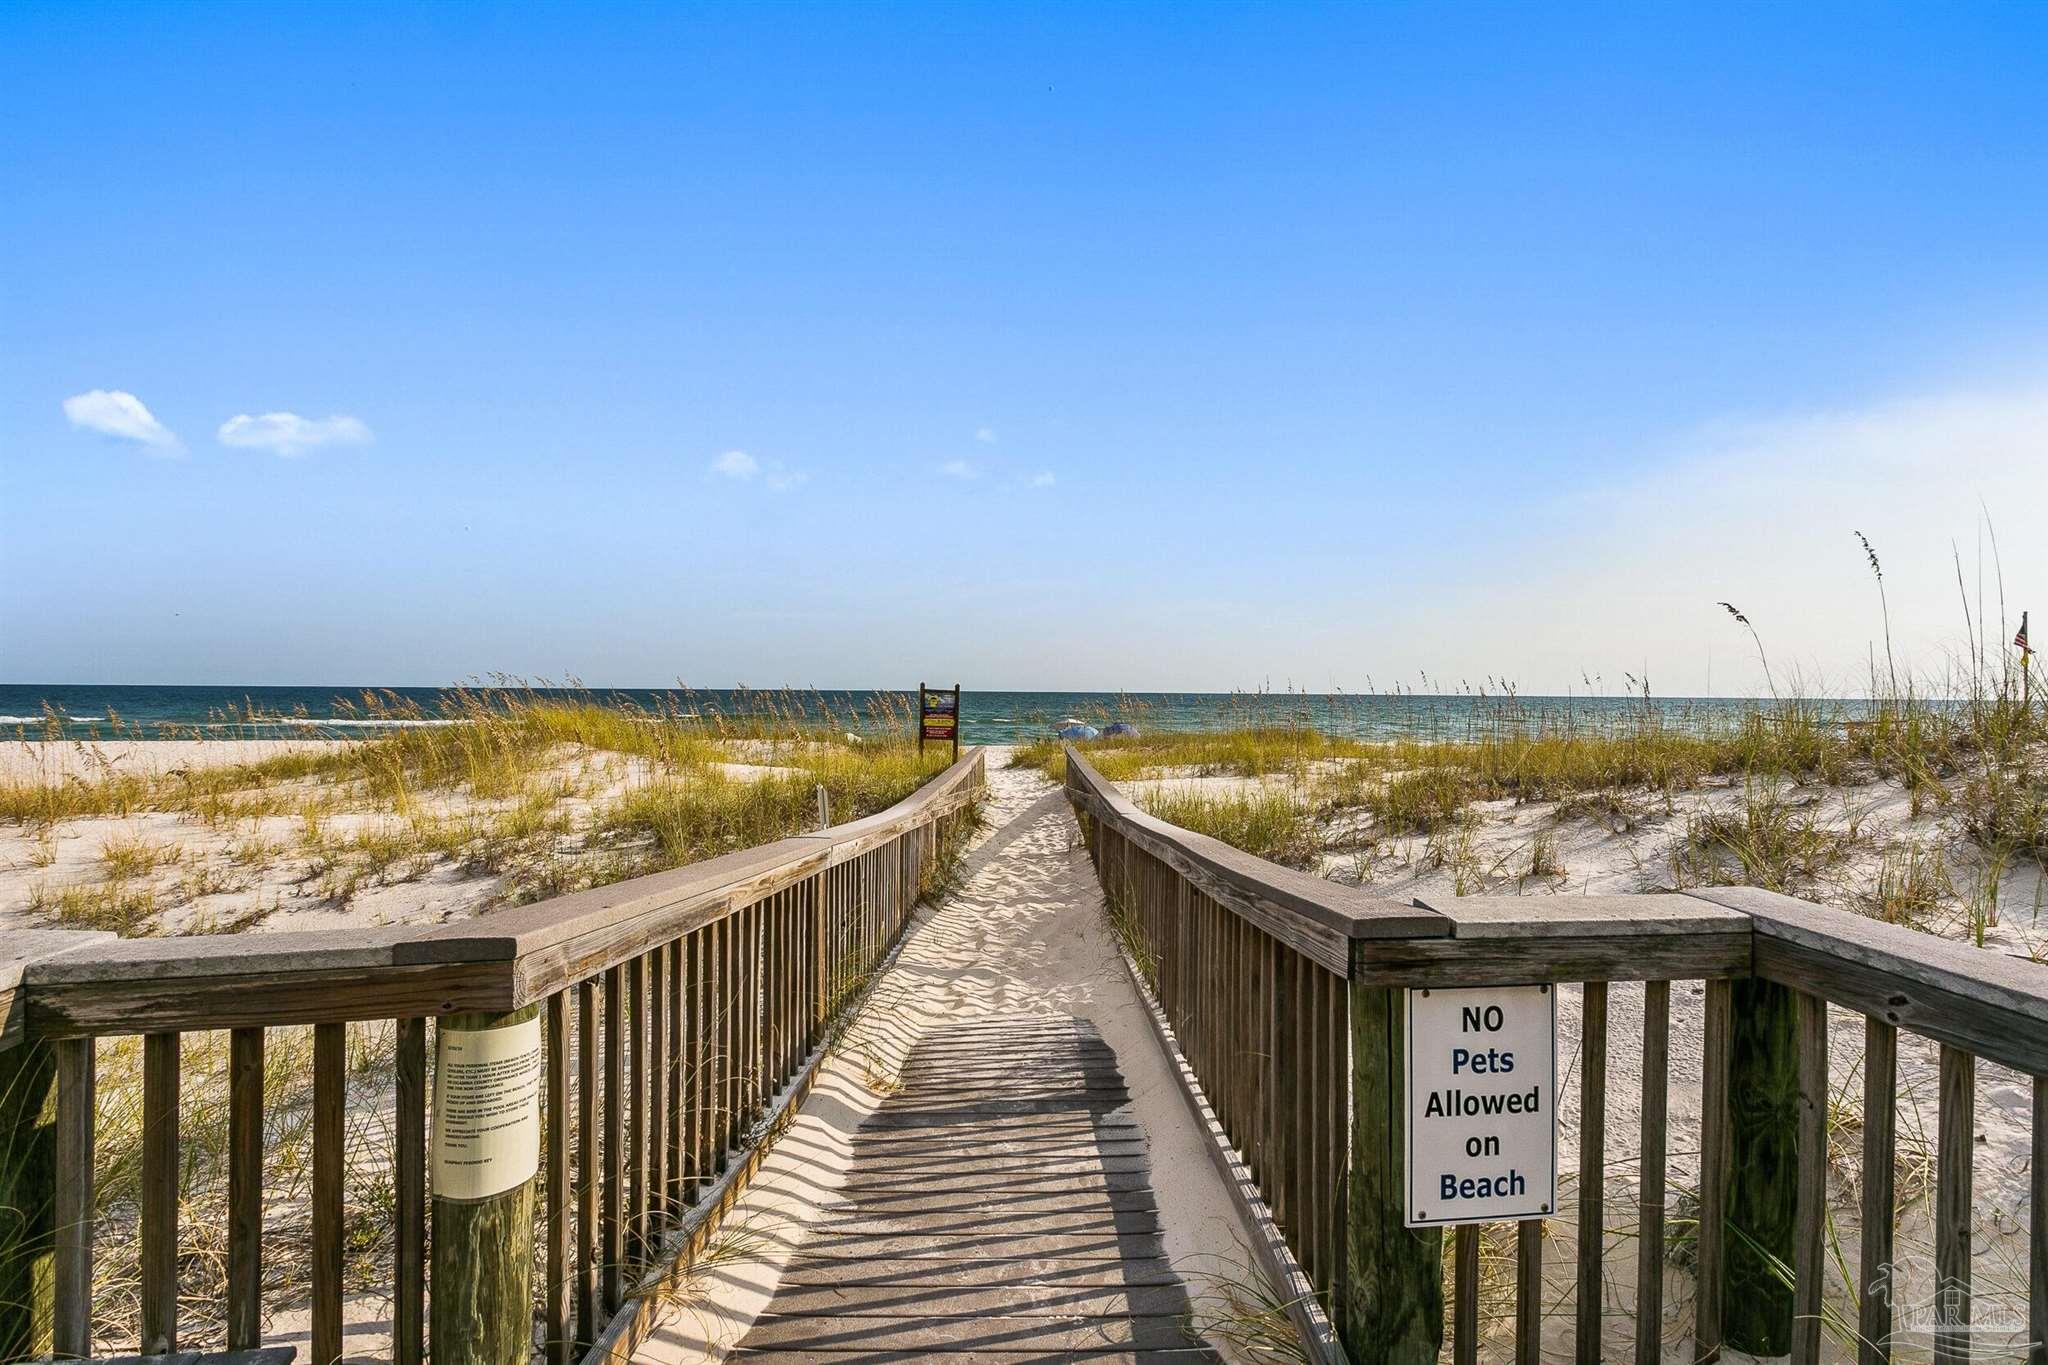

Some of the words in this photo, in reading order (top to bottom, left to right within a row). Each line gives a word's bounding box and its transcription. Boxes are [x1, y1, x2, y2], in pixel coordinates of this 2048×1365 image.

[1462, 1006, 1504, 1032] NO
[1453, 1048, 1514, 1075] Pets
[1425, 1086, 1539, 1118] Allowed
[1466, 1136, 1499, 1157] on
[1440, 1169, 1525, 1200] Beach
